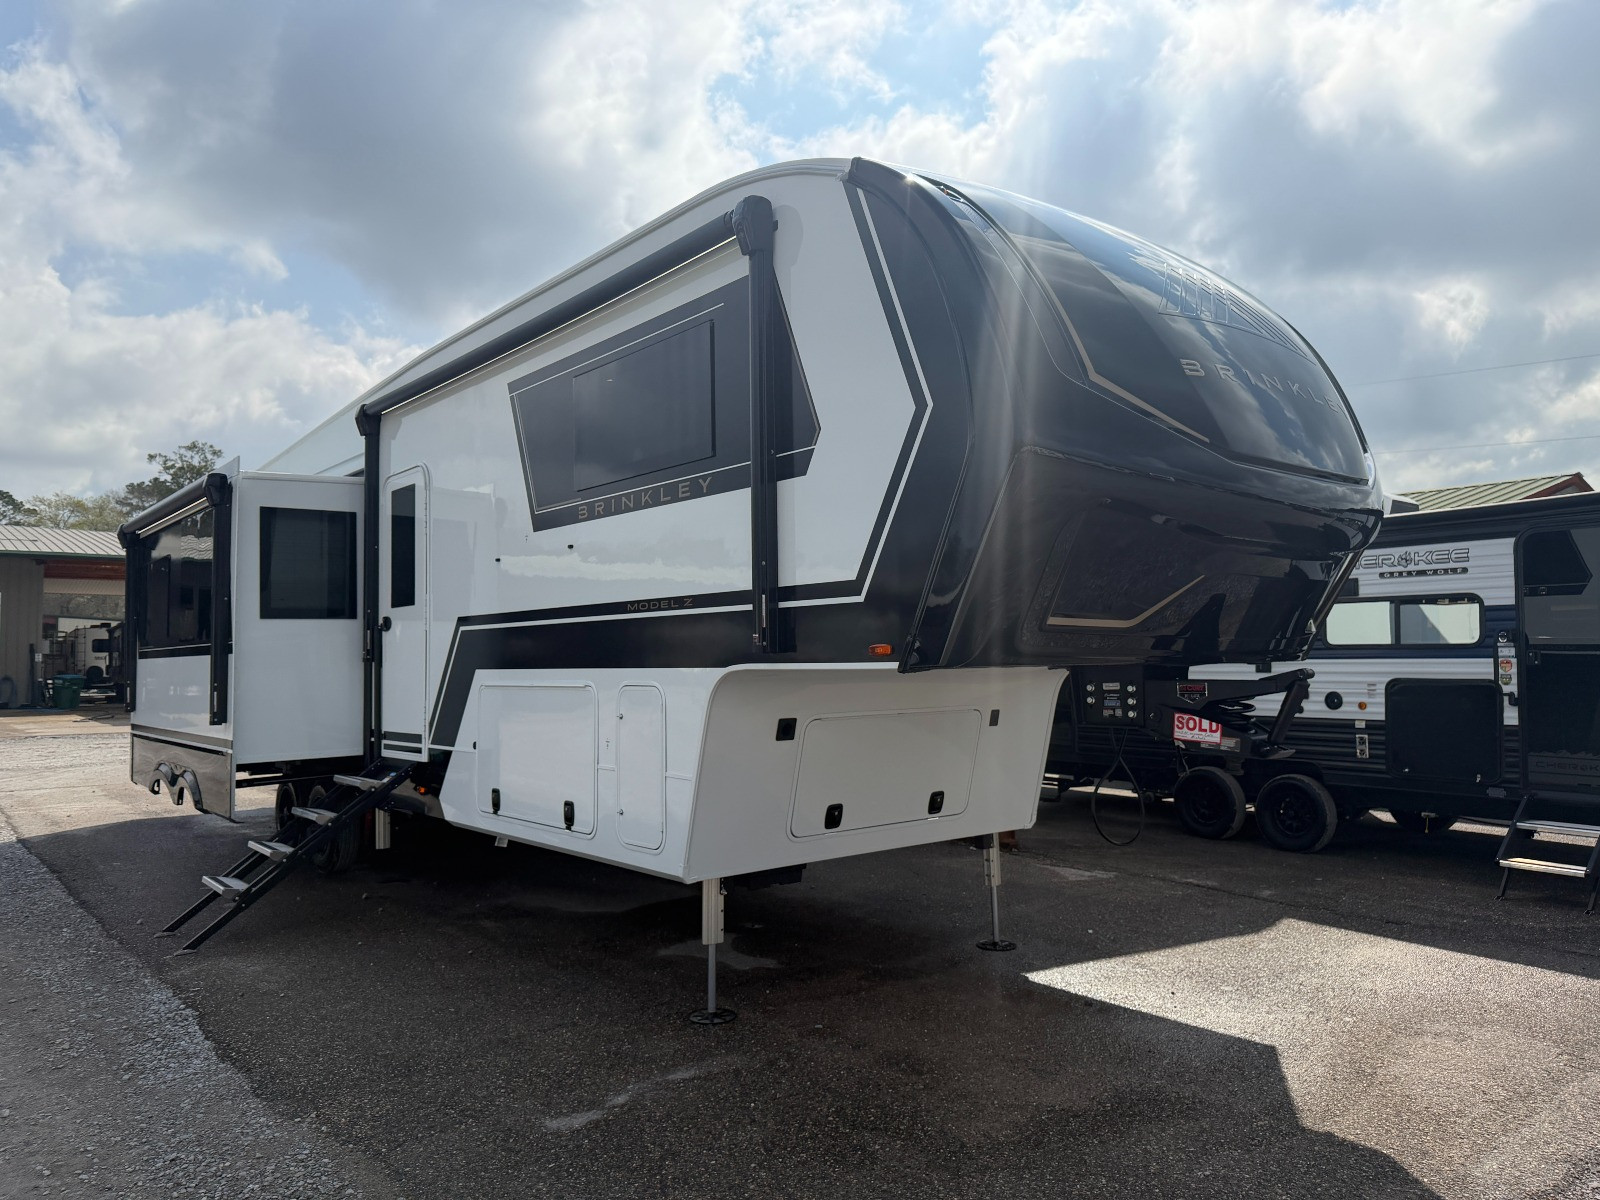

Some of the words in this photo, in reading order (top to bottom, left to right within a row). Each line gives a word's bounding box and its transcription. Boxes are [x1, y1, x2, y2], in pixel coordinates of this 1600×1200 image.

[578, 477, 713, 519] BRINKLEY
[1355, 547, 1470, 570] EROKEE
[1384, 570, 1417, 578] GREY
[627, 599, 679, 611] MODEL
[683, 598, 693, 606] Z
[1175, 715, 1220, 734] SOLD
